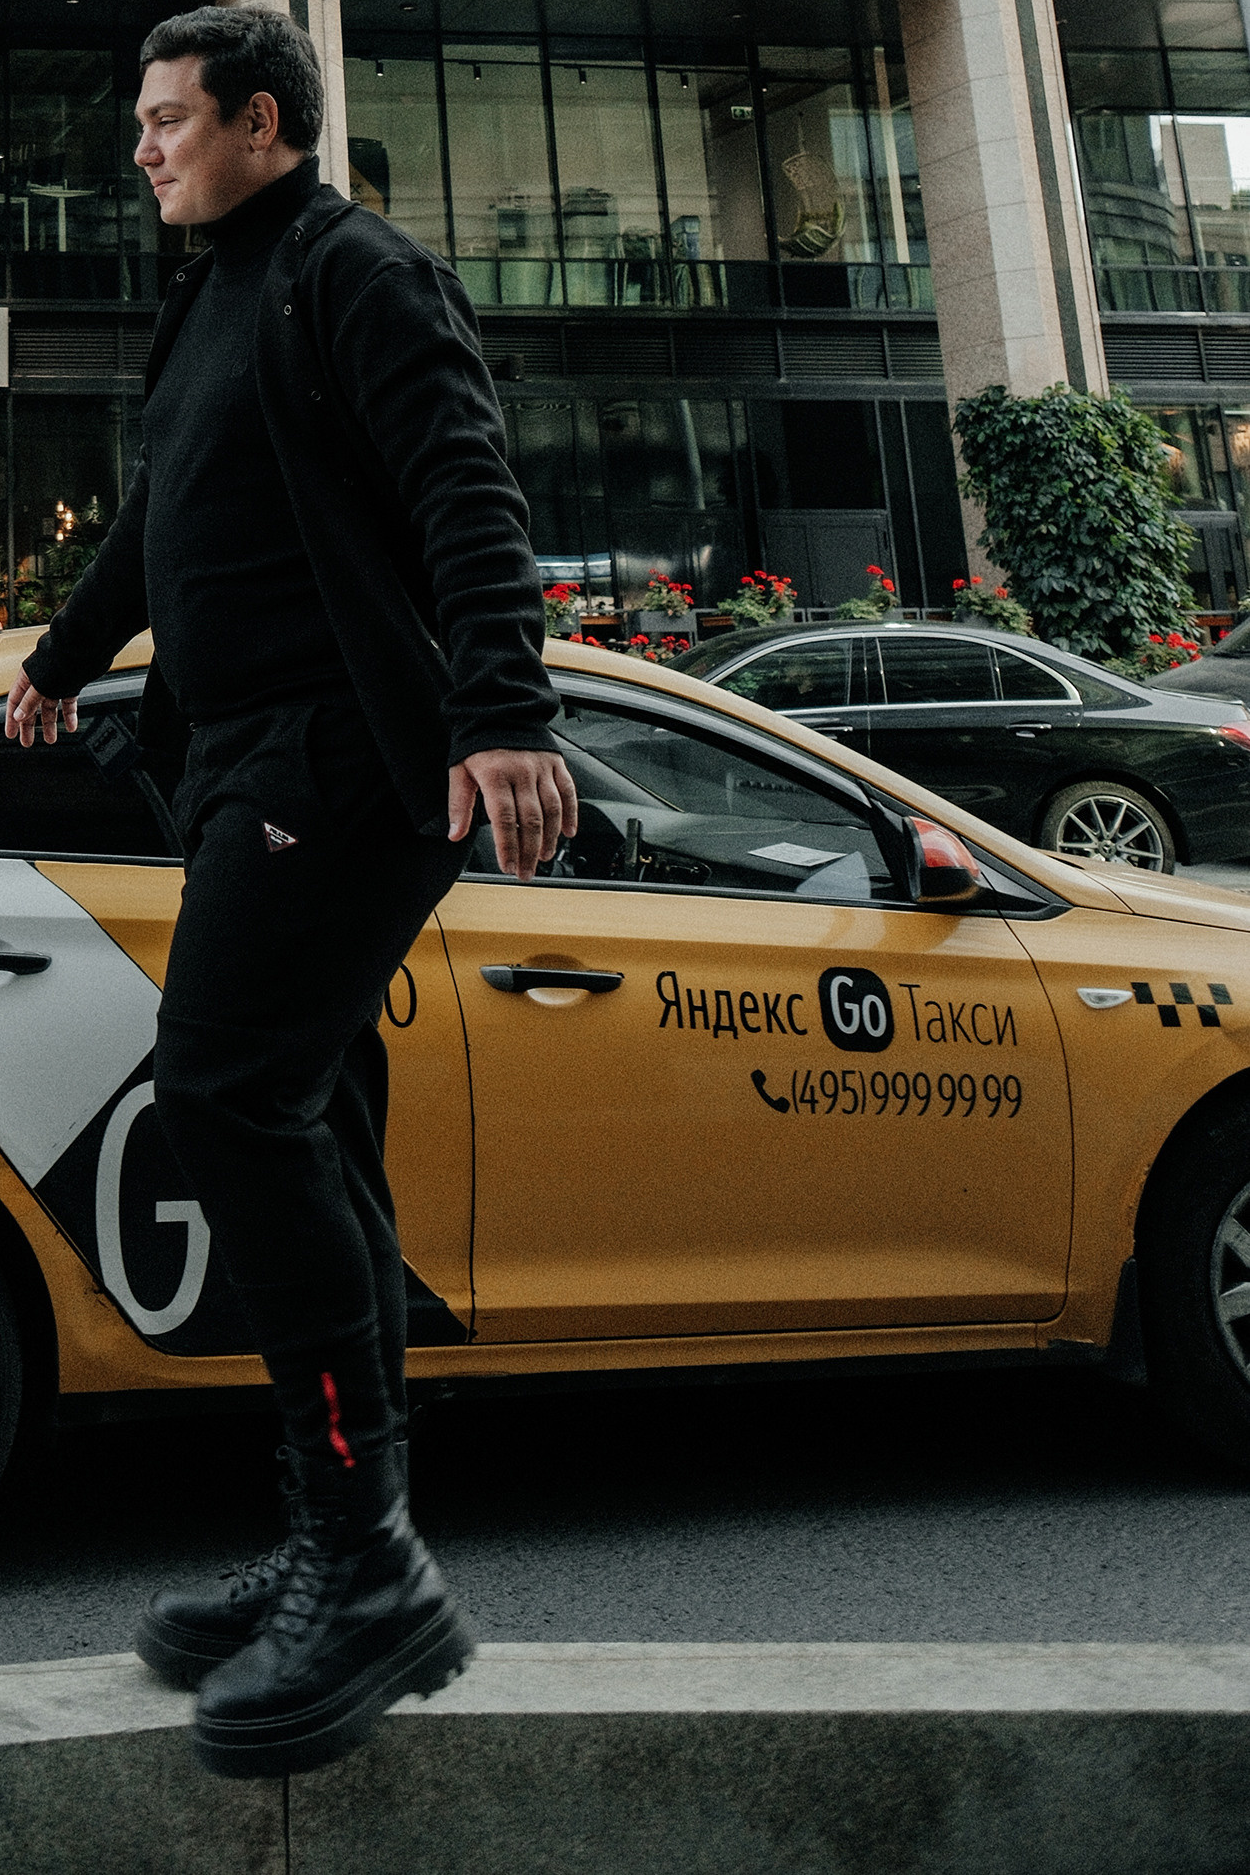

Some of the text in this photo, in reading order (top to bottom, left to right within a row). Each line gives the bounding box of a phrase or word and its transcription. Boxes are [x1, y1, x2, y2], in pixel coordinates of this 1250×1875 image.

[655, 970, 1019, 1047] Яндекс Go Такси
